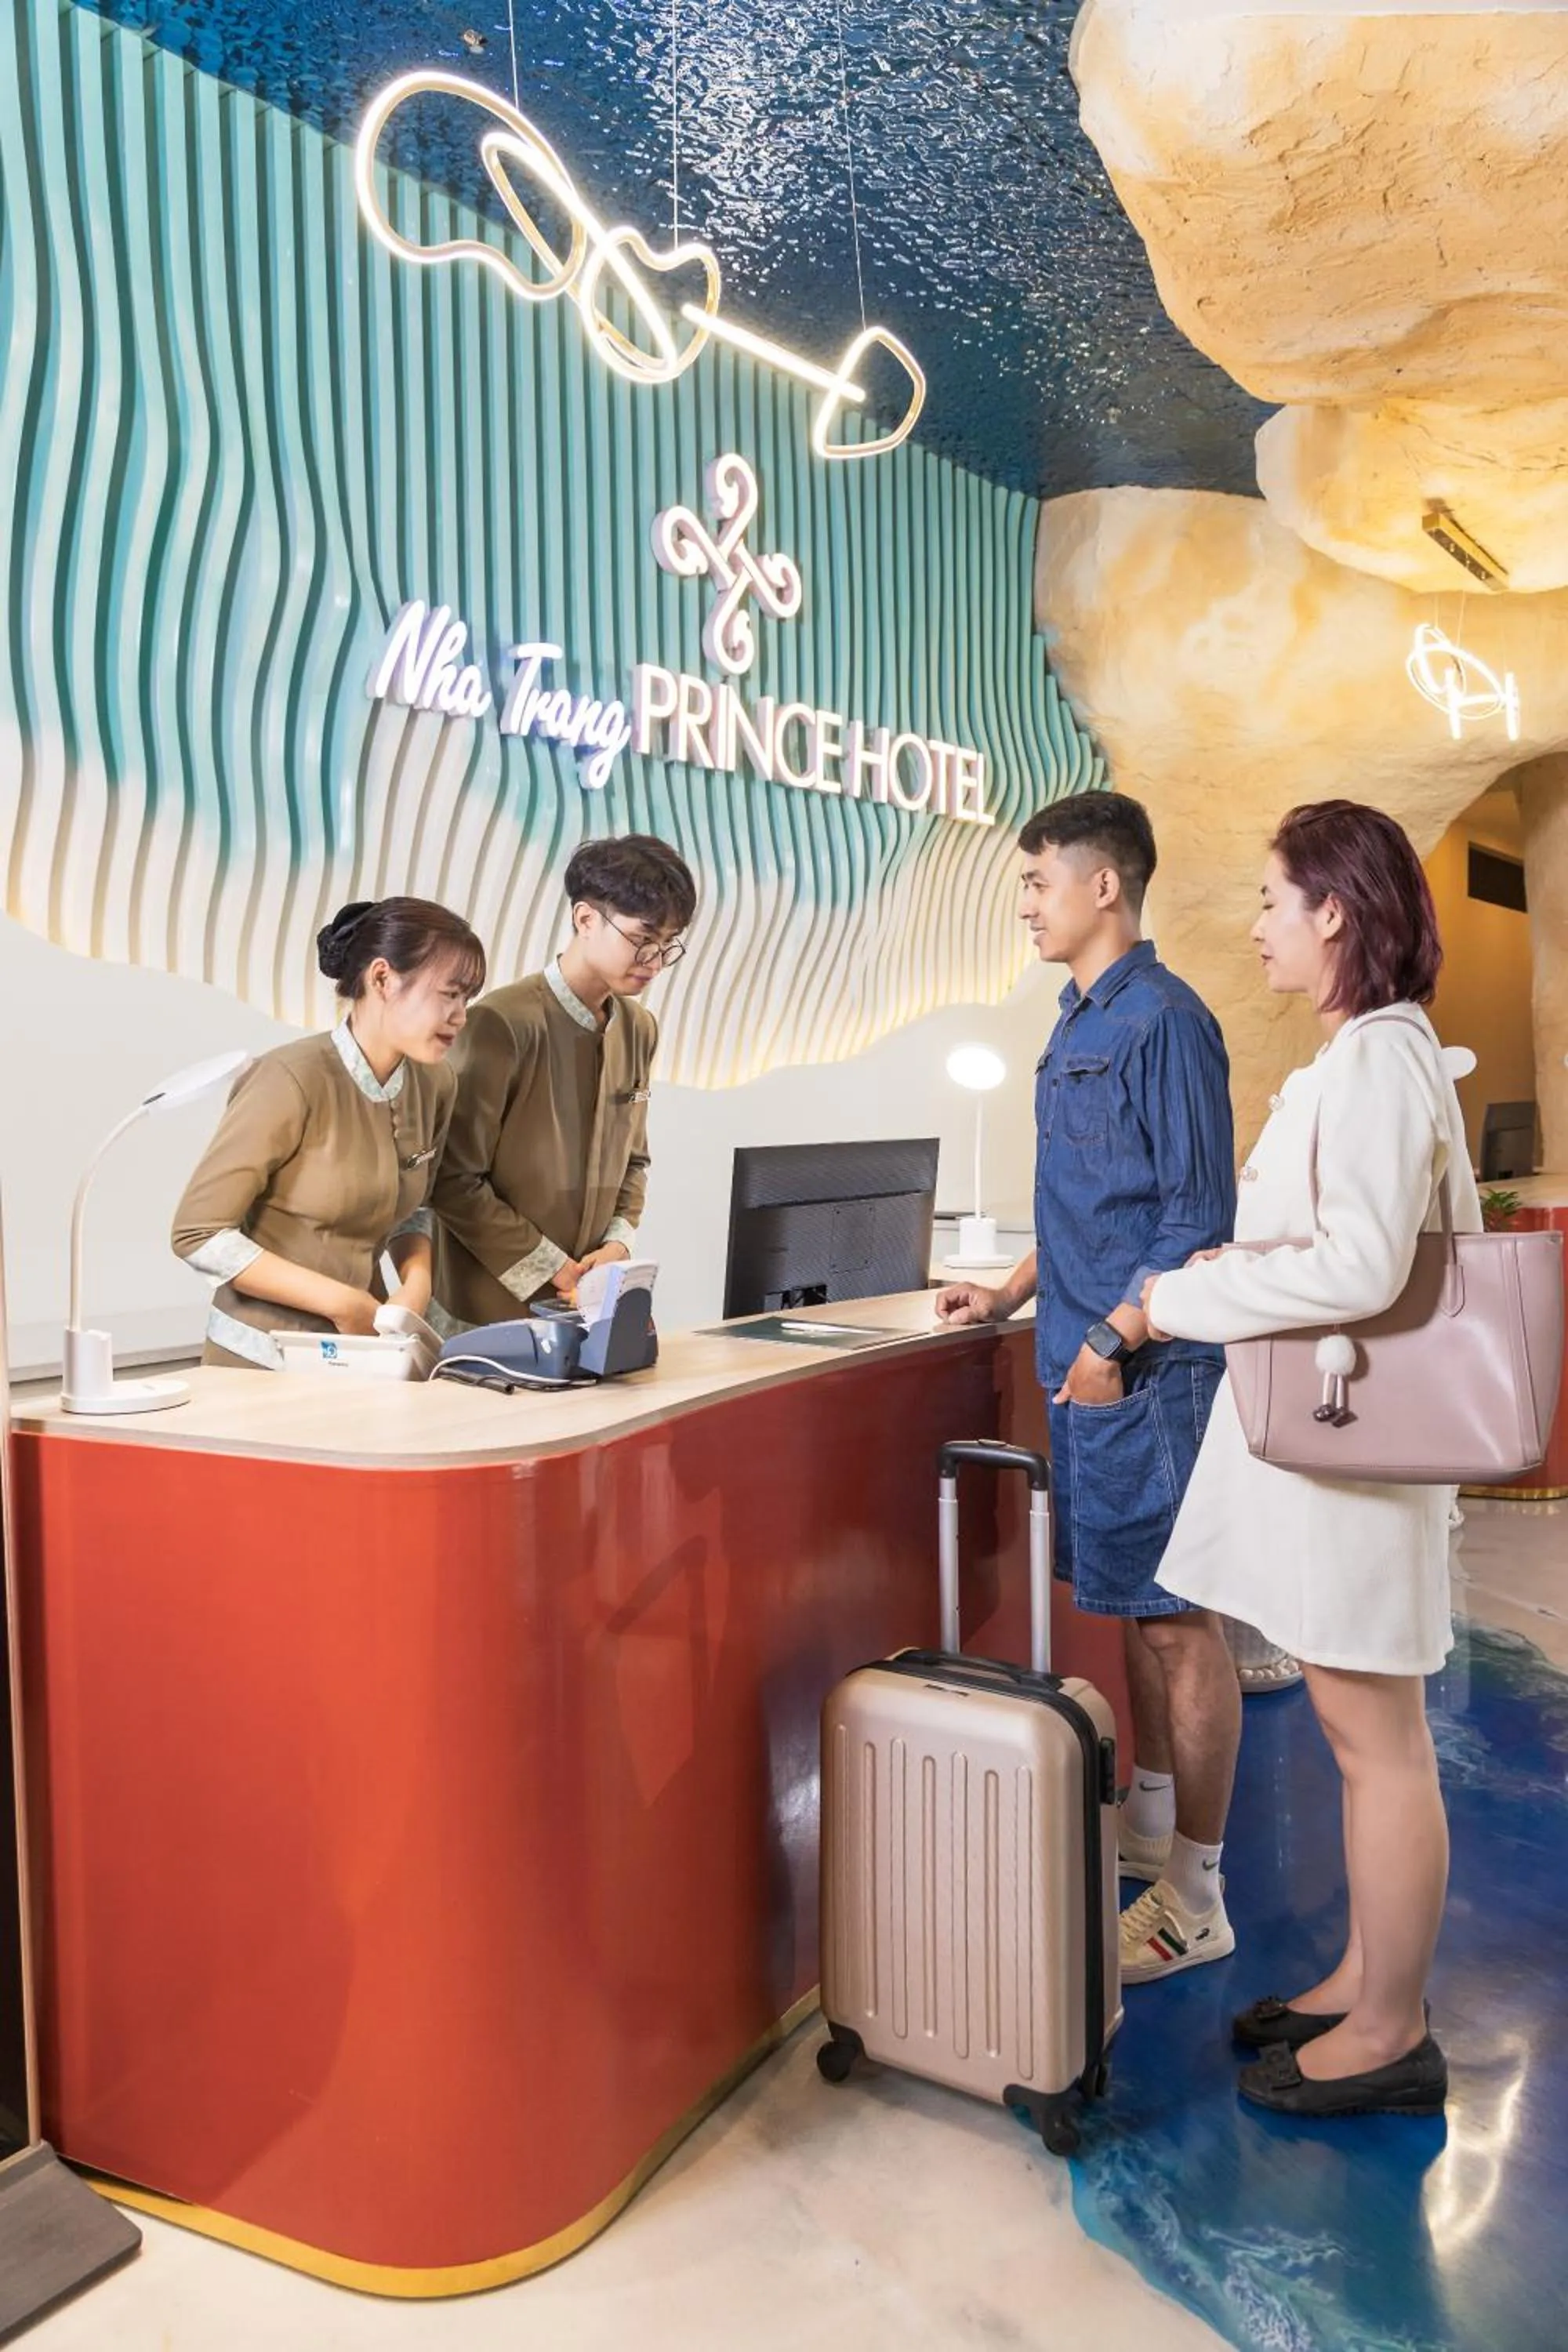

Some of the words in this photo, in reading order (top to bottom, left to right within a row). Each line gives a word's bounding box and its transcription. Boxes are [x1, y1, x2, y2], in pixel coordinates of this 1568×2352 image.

[369, 599, 492, 718] Nha
[504, 641, 632, 790] Trang
[633, 662, 843, 793] PRINCE
[848, 719, 996, 826] HOTEL
